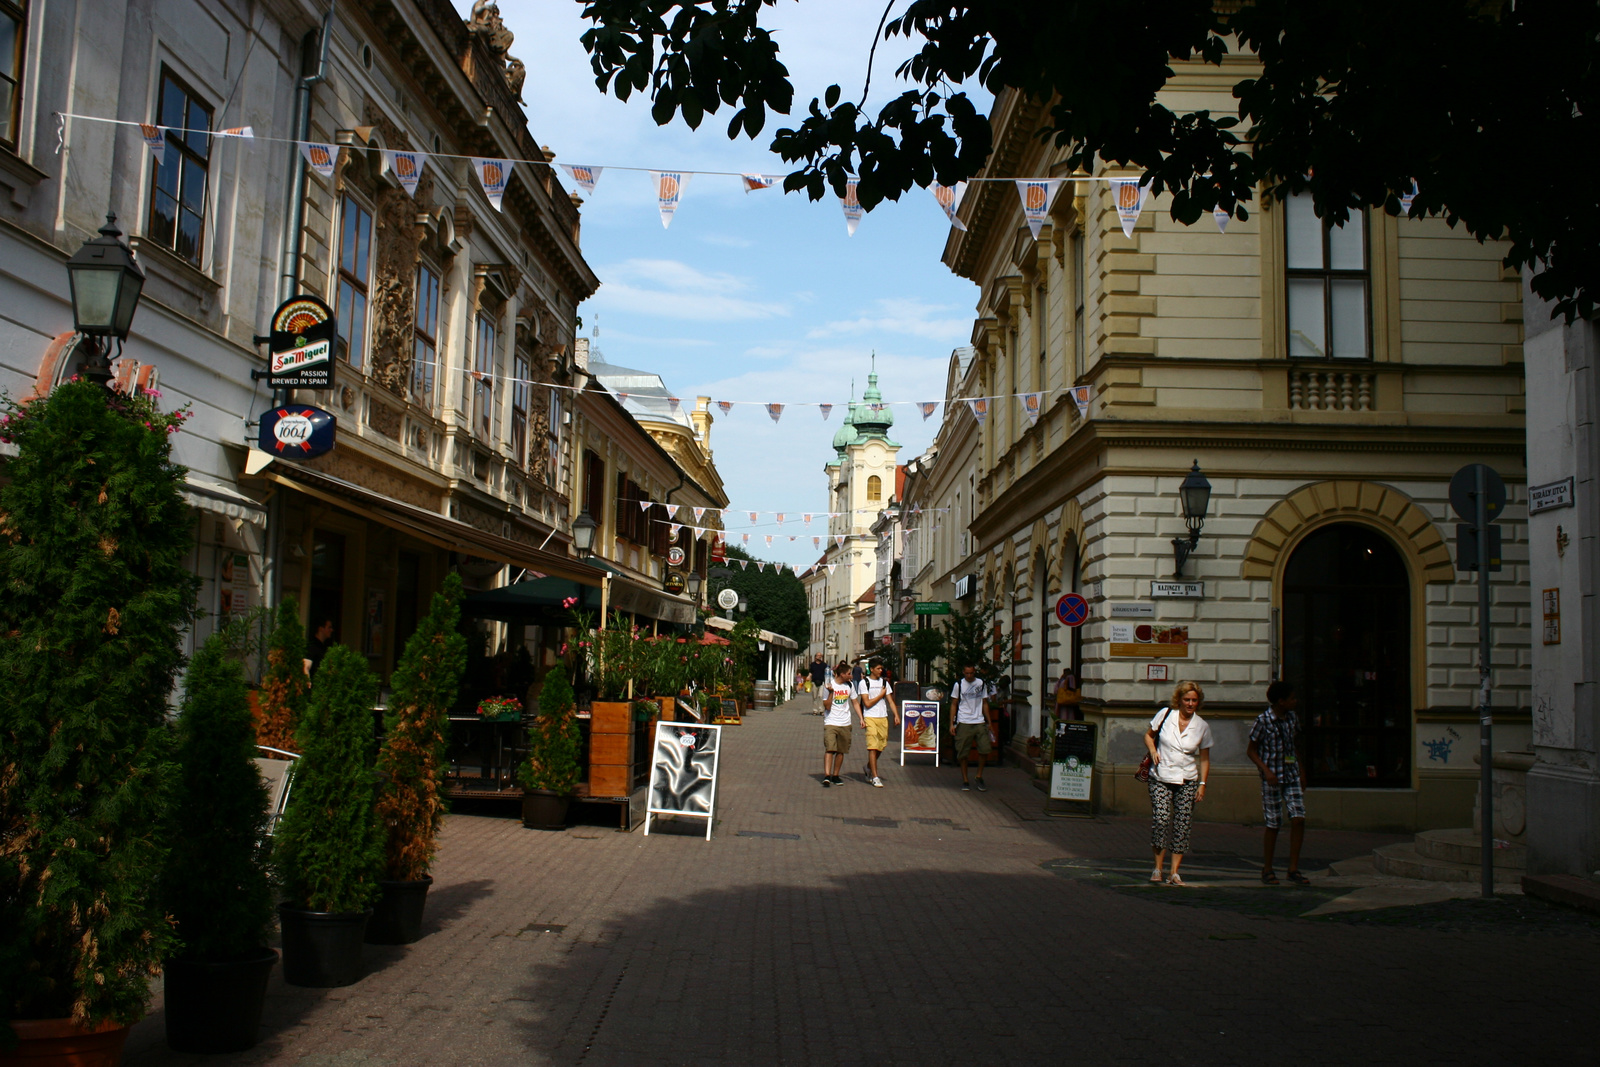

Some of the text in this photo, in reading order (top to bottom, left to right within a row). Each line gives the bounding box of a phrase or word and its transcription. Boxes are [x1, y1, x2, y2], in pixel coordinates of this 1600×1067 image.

[294, 344, 327, 364] Miguel
[279, 426, 306, 440] 1664
[1532, 486, 1567, 500] KIRÁLY UTCA
